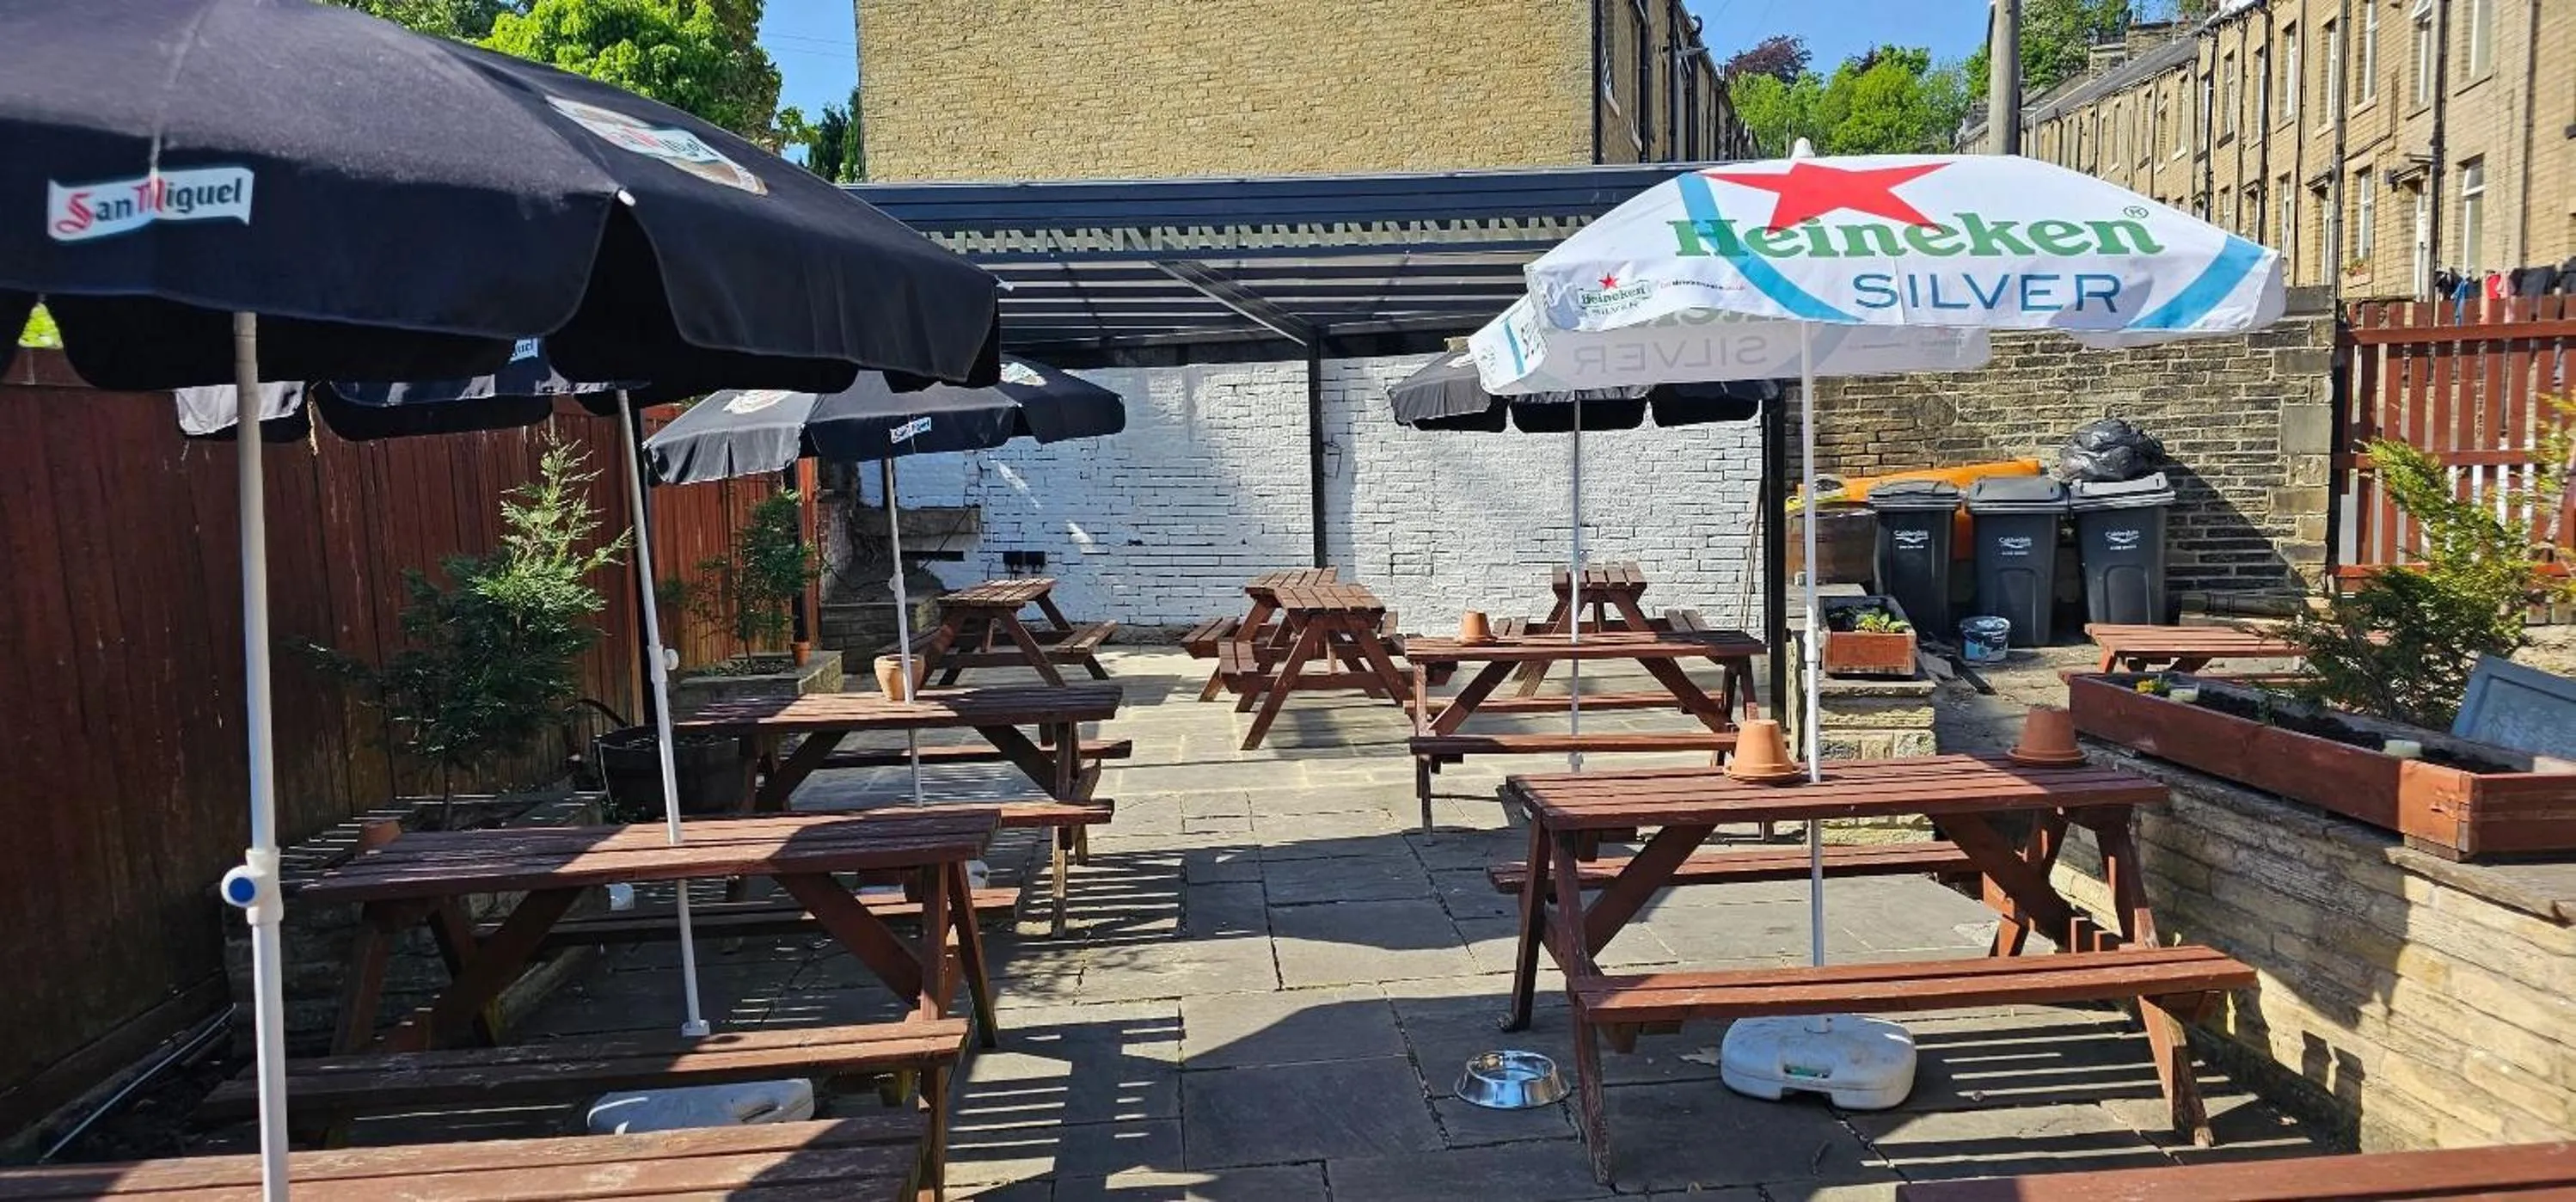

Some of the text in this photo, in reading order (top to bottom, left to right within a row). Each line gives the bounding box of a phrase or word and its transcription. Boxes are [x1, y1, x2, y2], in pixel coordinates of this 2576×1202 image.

[56, 175, 243, 234] San Miguel
[1665, 212, 2166, 258] Heineken
[1852, 273, 2124, 314] SILVER
